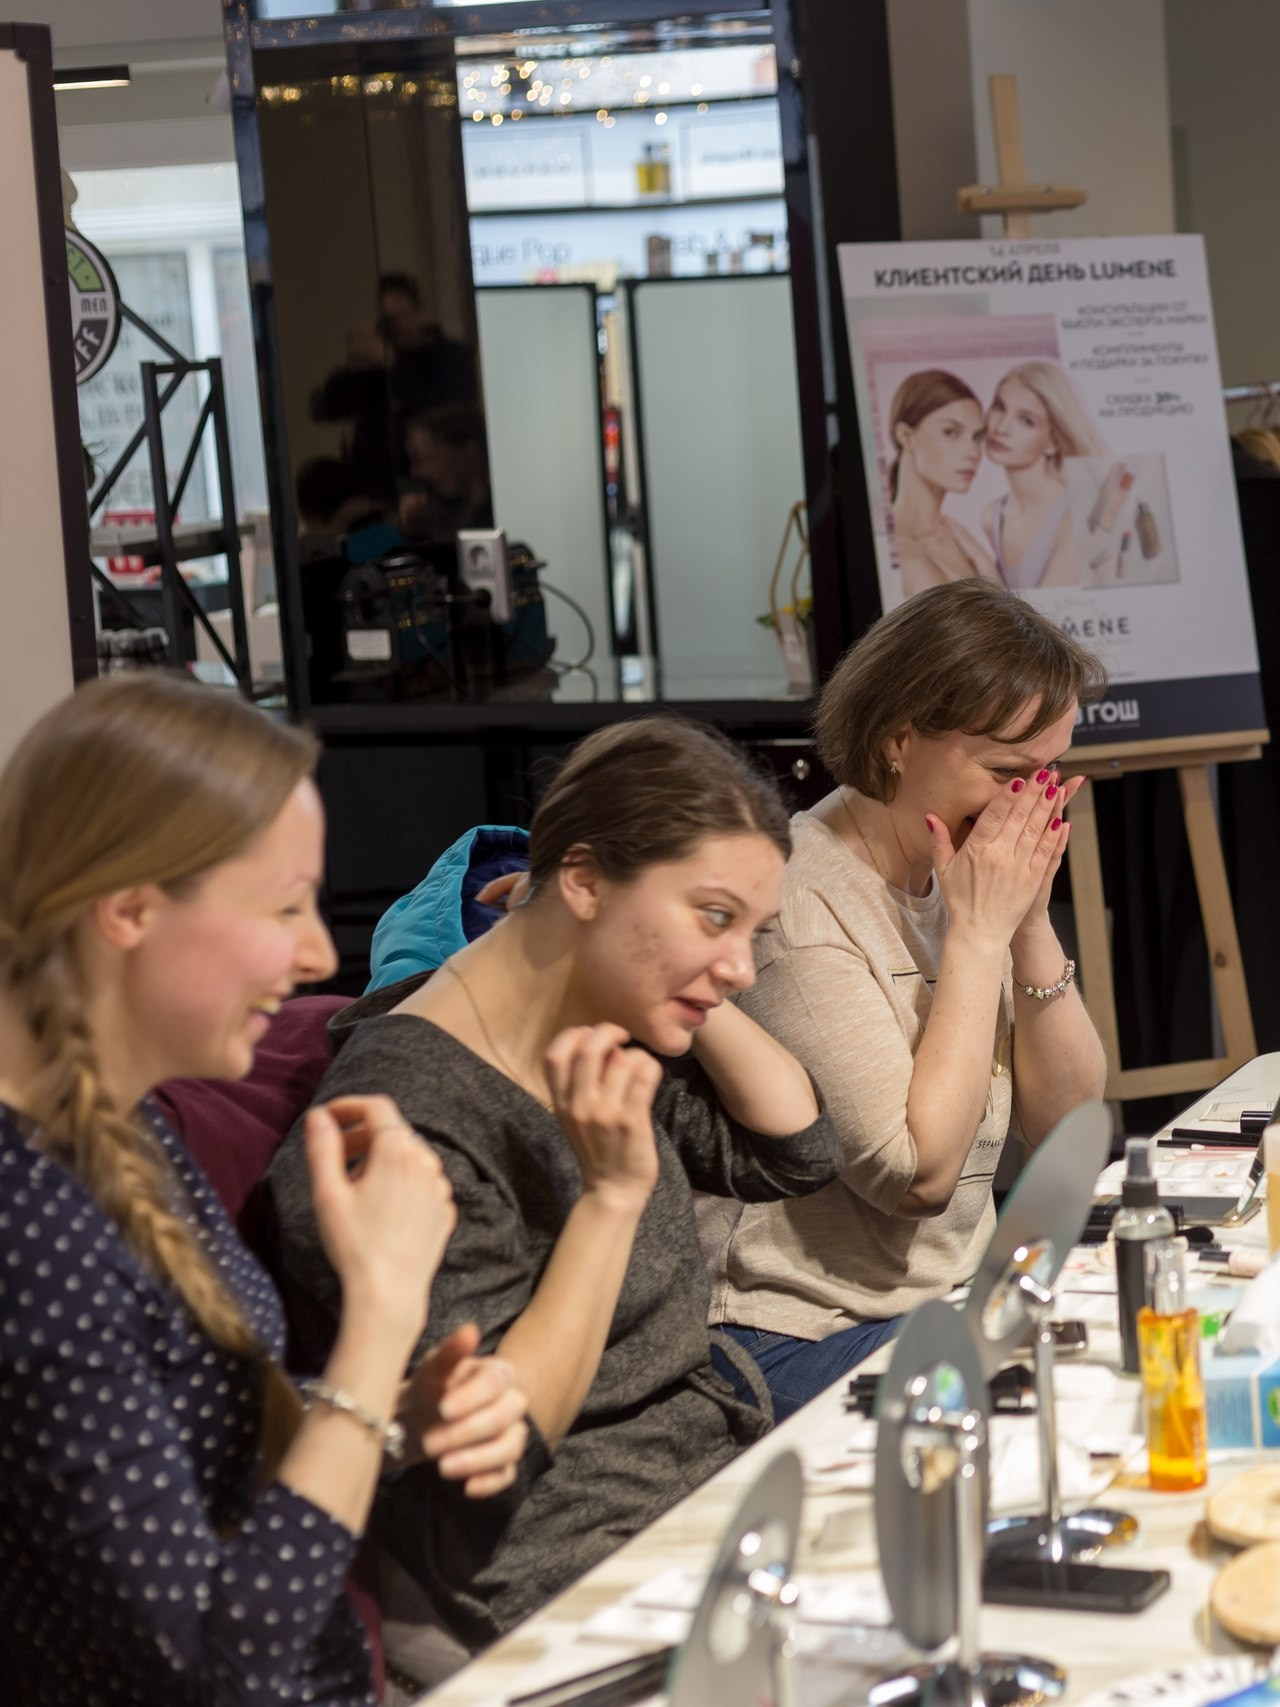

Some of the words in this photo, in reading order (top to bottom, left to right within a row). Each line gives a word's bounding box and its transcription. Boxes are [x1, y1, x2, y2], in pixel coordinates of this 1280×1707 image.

[874, 260, 1023, 288] КЛИЕНТСКИЙ
[1028, 262, 1086, 284] ДЕНЬ
[1090, 259, 1177, 281] LUMENE
[1062, 617, 1130, 637] MENE
